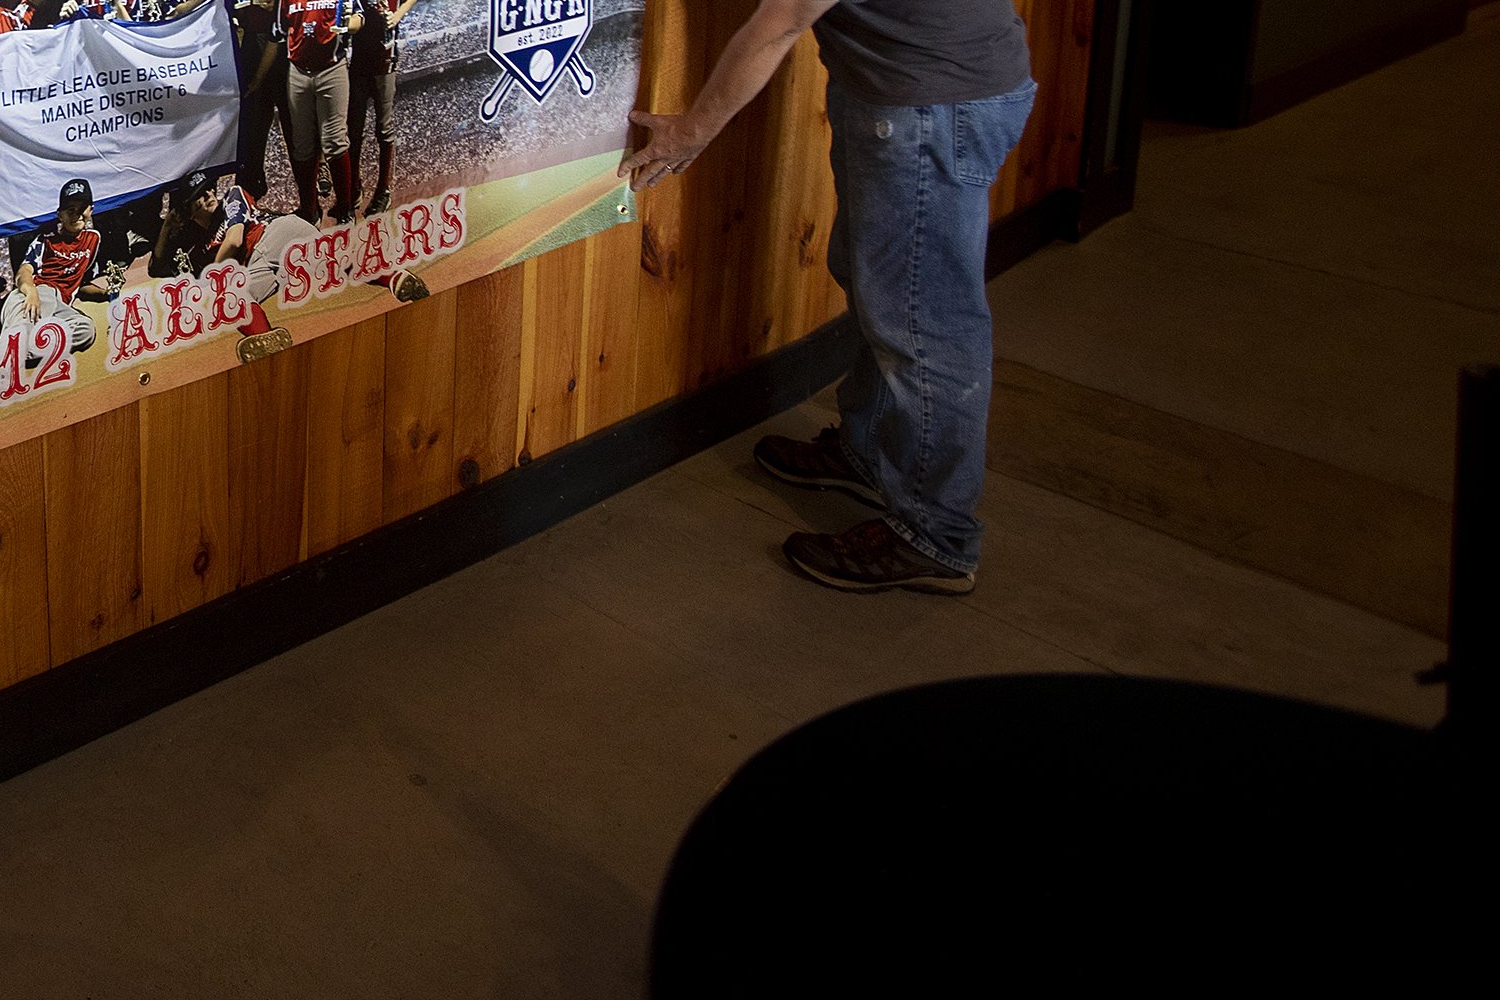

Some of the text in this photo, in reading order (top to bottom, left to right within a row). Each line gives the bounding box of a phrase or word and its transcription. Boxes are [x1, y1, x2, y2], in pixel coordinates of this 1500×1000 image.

[288, 0, 337, 15] ALL STARS
[517, 24, 564, 47] est. 2022
[1, 55, 219, 107] LITTLE LEAGUE BASEBALL
[41, 83, 187, 124] MAINE DISTRICT 6
[65, 106, 165, 142] CHAMPIONS
[110, 264, 249, 366] ALL
[280, 191, 464, 304] STARS
